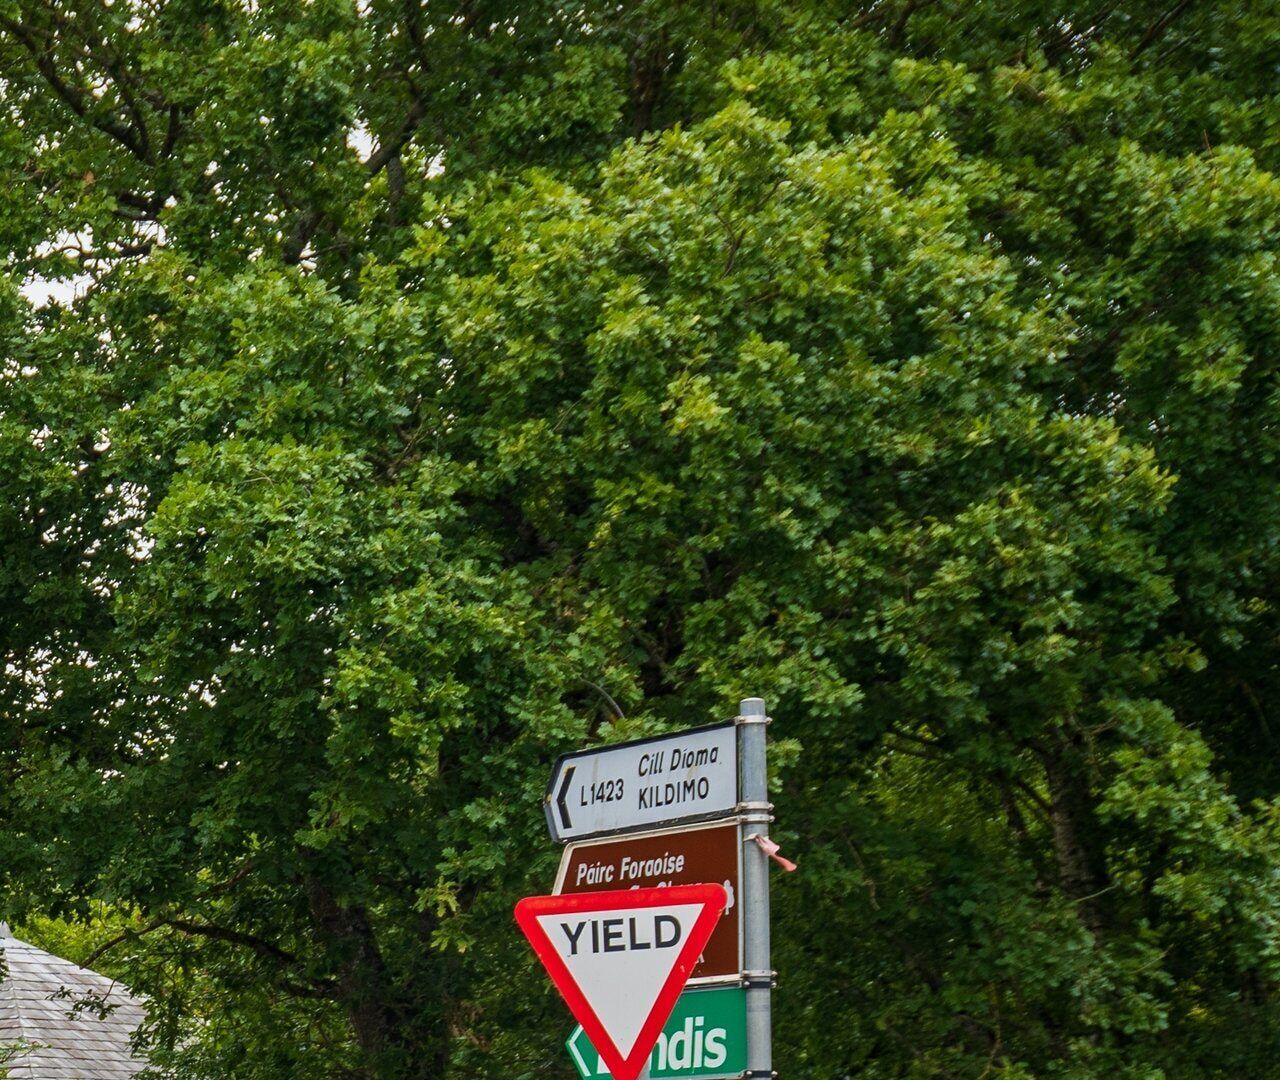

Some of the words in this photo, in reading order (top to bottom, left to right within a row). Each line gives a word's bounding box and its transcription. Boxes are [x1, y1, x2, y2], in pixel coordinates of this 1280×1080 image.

[638, 751, 664, 777] Cill
[580, 779, 624, 807] L1423
[638, 777, 709, 810] KILDIMO
[576, 862, 614, 887] Páirc
[620, 851, 685, 881] Foraoise
[560, 914, 682, 956] YIELD
